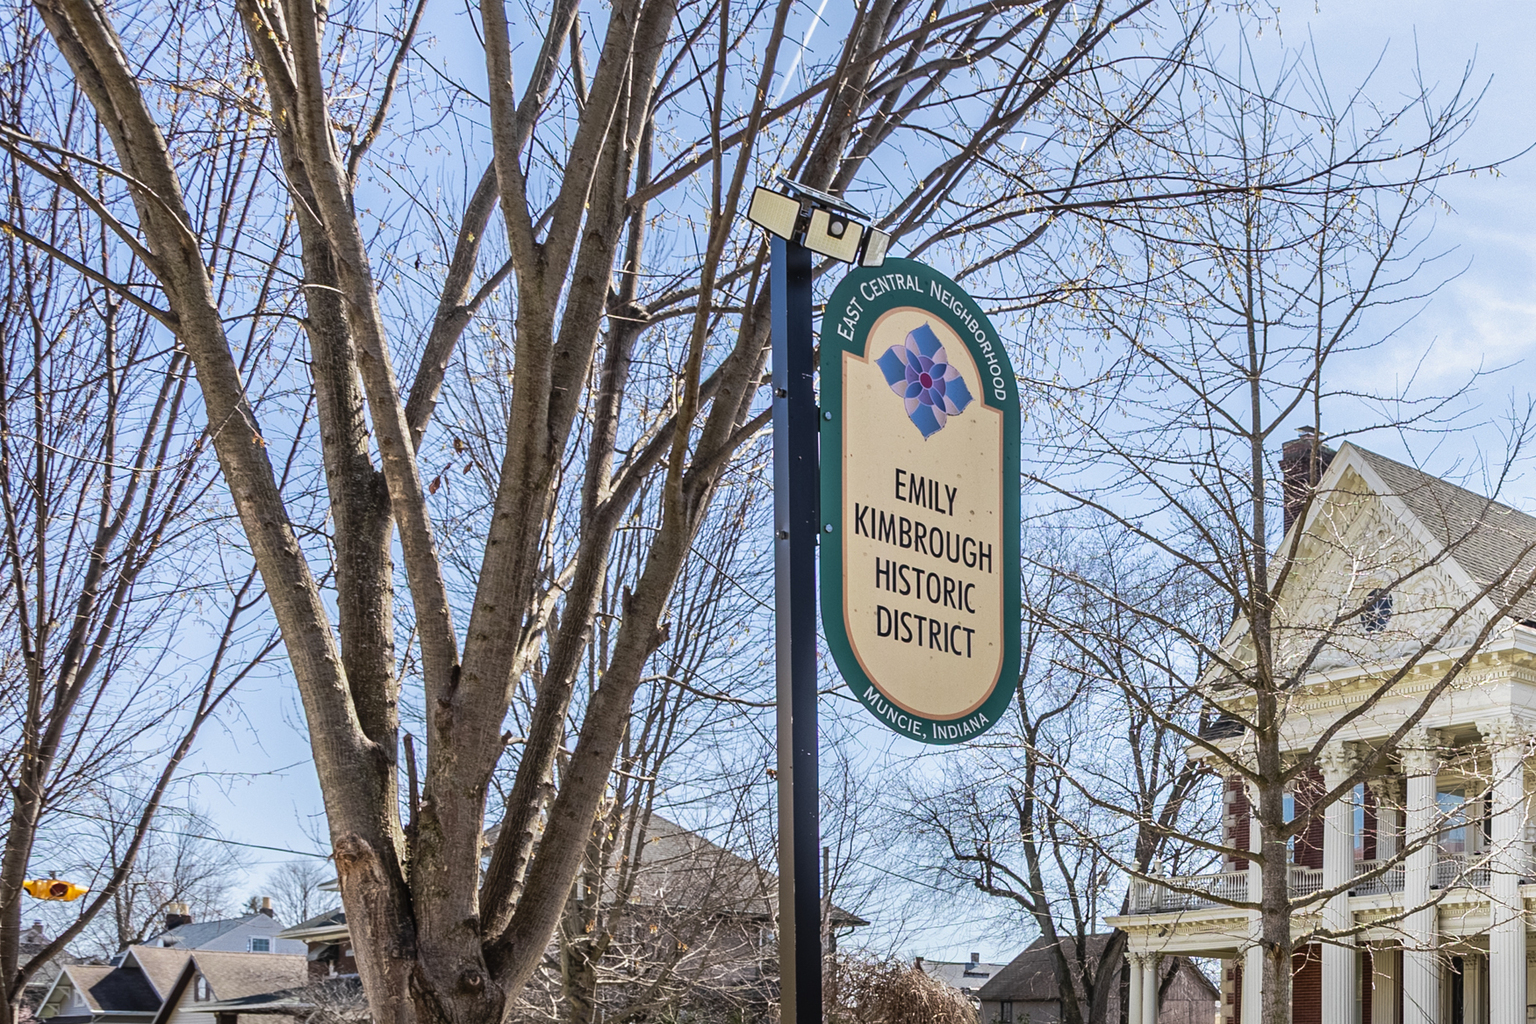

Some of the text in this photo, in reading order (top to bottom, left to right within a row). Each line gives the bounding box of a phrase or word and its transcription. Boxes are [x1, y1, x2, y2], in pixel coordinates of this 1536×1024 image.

[837, 273, 1007, 401] EAST CENTRAL NEIGHBORHOOD
[895, 467, 957, 517] EMILY
[854, 502, 993, 574] KIMBROUGH
[875, 556, 976, 614] HISTORIC
[876, 604, 976, 659] DISTRICT
[863, 685, 990, 740] MUNCIE, INDIANA
